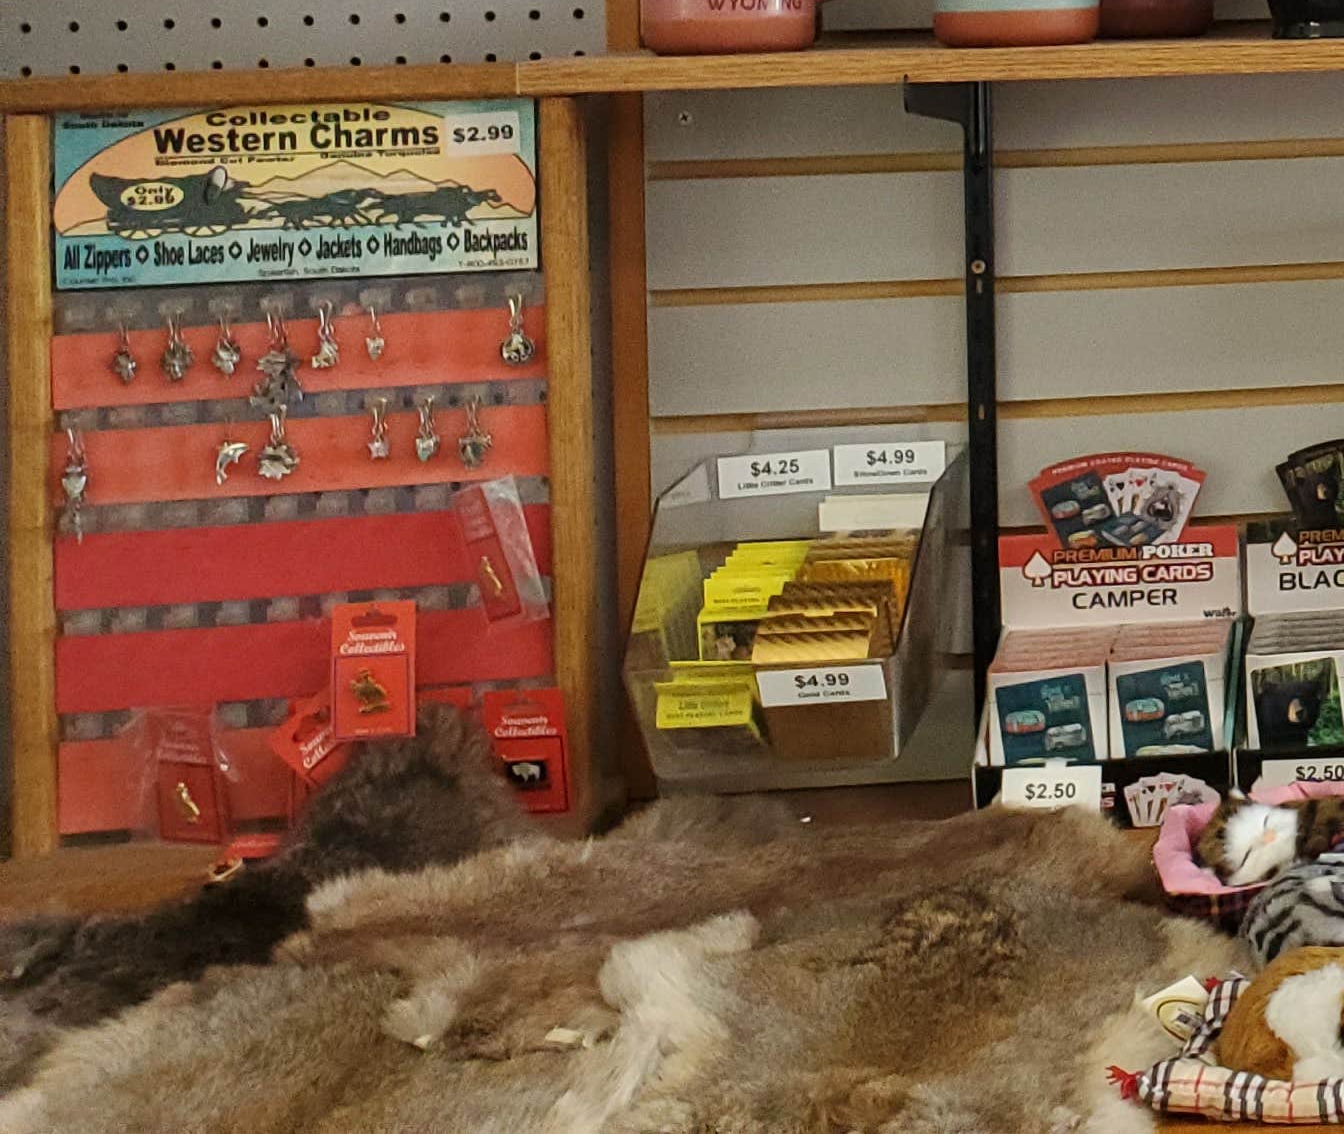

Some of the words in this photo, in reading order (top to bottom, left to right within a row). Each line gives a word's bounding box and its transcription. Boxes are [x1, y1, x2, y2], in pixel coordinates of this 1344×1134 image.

[206, 107, 391, 127] Collectable
[154, 127, 297, 154] Western
[310, 122, 439, 149] Charms
[453, 124, 514, 144] $2.99
[134, 185, 174, 196] Only
[64, 246, 80, 270] All
[84, 244, 131, 275] Zippers
[154, 242, 184, 266] Shoe
[188, 240, 225, 265] Laces
[247, 236, 294, 266] Jewelry
[316, 234, 362, 260] Jackets
[384, 230, 442, 260] Handbags
[464, 227, 528, 259] Backpacks
[866, 449, 916, 466] $4.99
[750, 459, 800, 477] $4.25
[788, 477, 814, 487] Cards
[1053, 547, 1138, 564] PREMIUM
[1142, 542, 1214, 560] POKER
[1053, 566, 1138, 588] PLAYING
[1141, 563, 1212, 581] CARDS
[1072, 587, 1177, 610] CAMPER
[794, 672, 850, 689] $4.99
[822, 689, 851, 698] Cards
[1295, 764, 1344, 782] $2.50
[1025, 782, 1076, 801] $2.50
